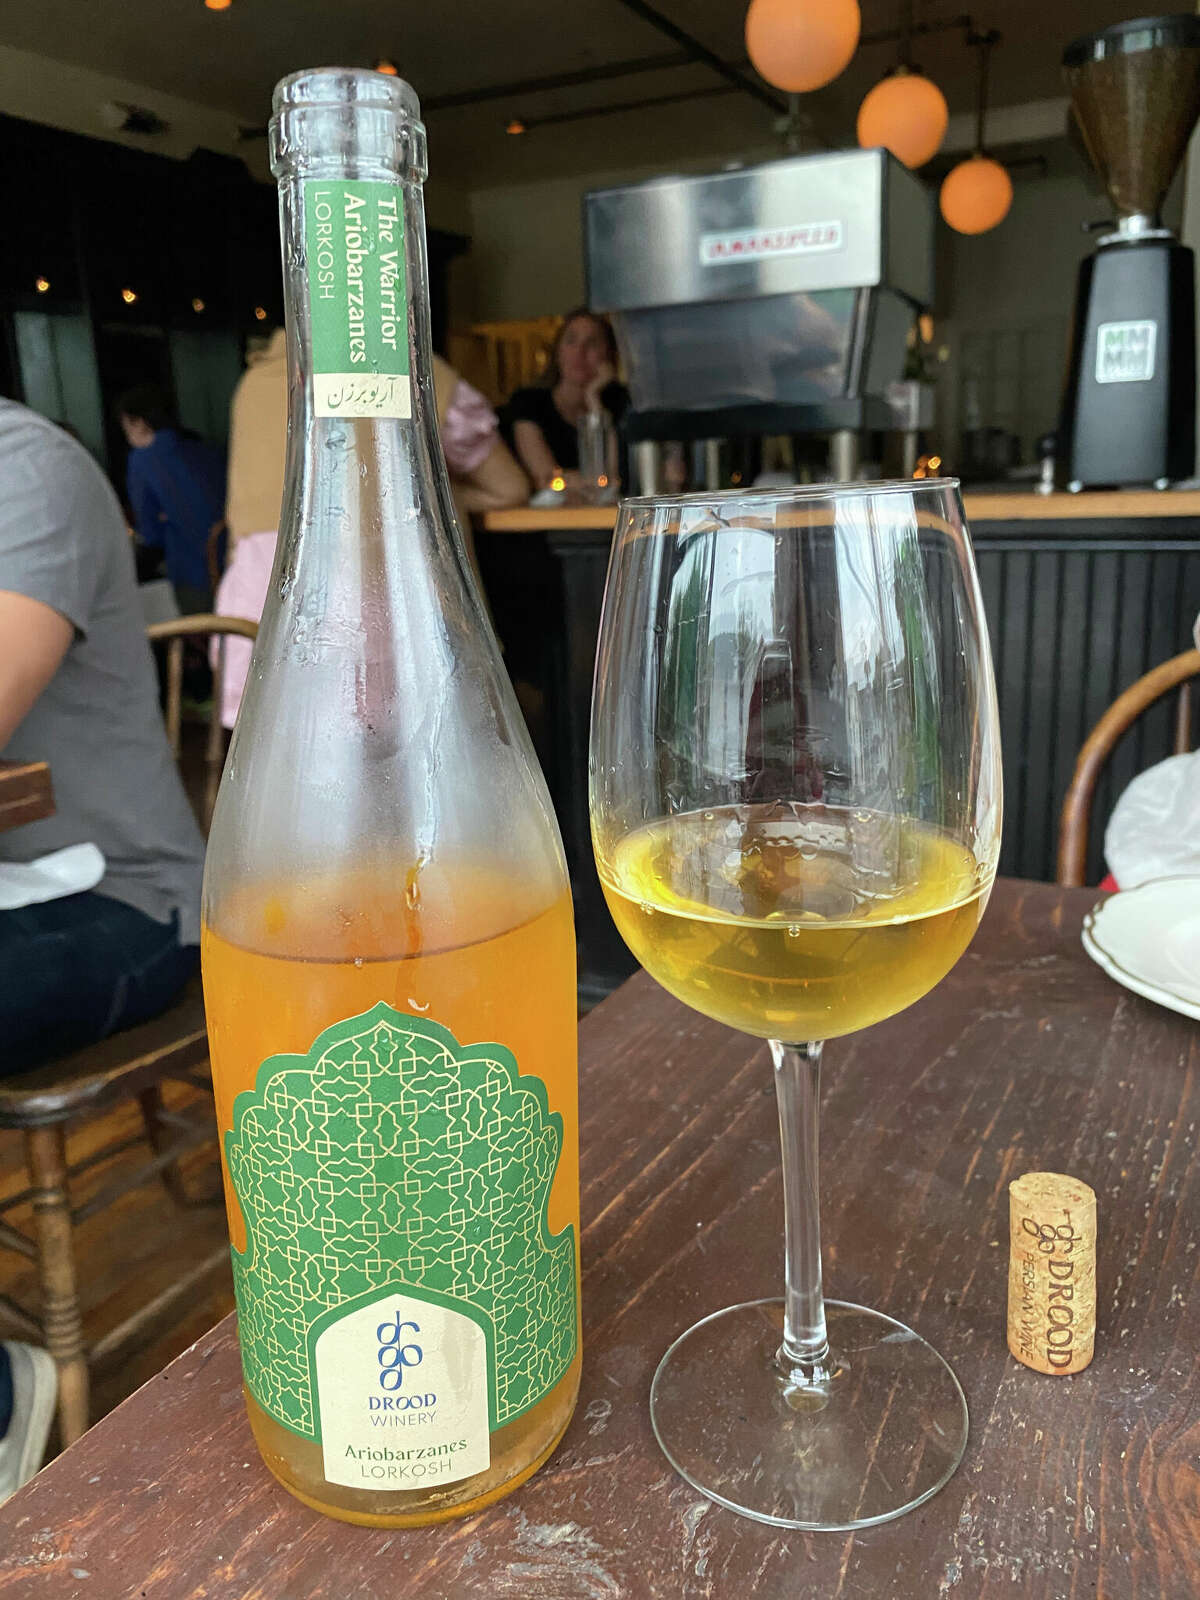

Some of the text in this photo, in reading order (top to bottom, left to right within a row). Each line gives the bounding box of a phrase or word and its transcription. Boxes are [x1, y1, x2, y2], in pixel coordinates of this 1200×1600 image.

[314, 191, 335, 299] LORKOSH
[377, 196, 401, 351] The Warrior
[343, 192, 369, 364] Ariobarzanes
[1020, 1252, 1035, 1313] PERSIAN
[1047, 1261, 1074, 1368] DROOD
[368, 1393, 437, 1410] DROOD
[370, 1410, 437, 1427] WINERY
[345, 1439, 467, 1461] Ariobarzanes
[361, 1459, 452, 1479] LORKOSH
